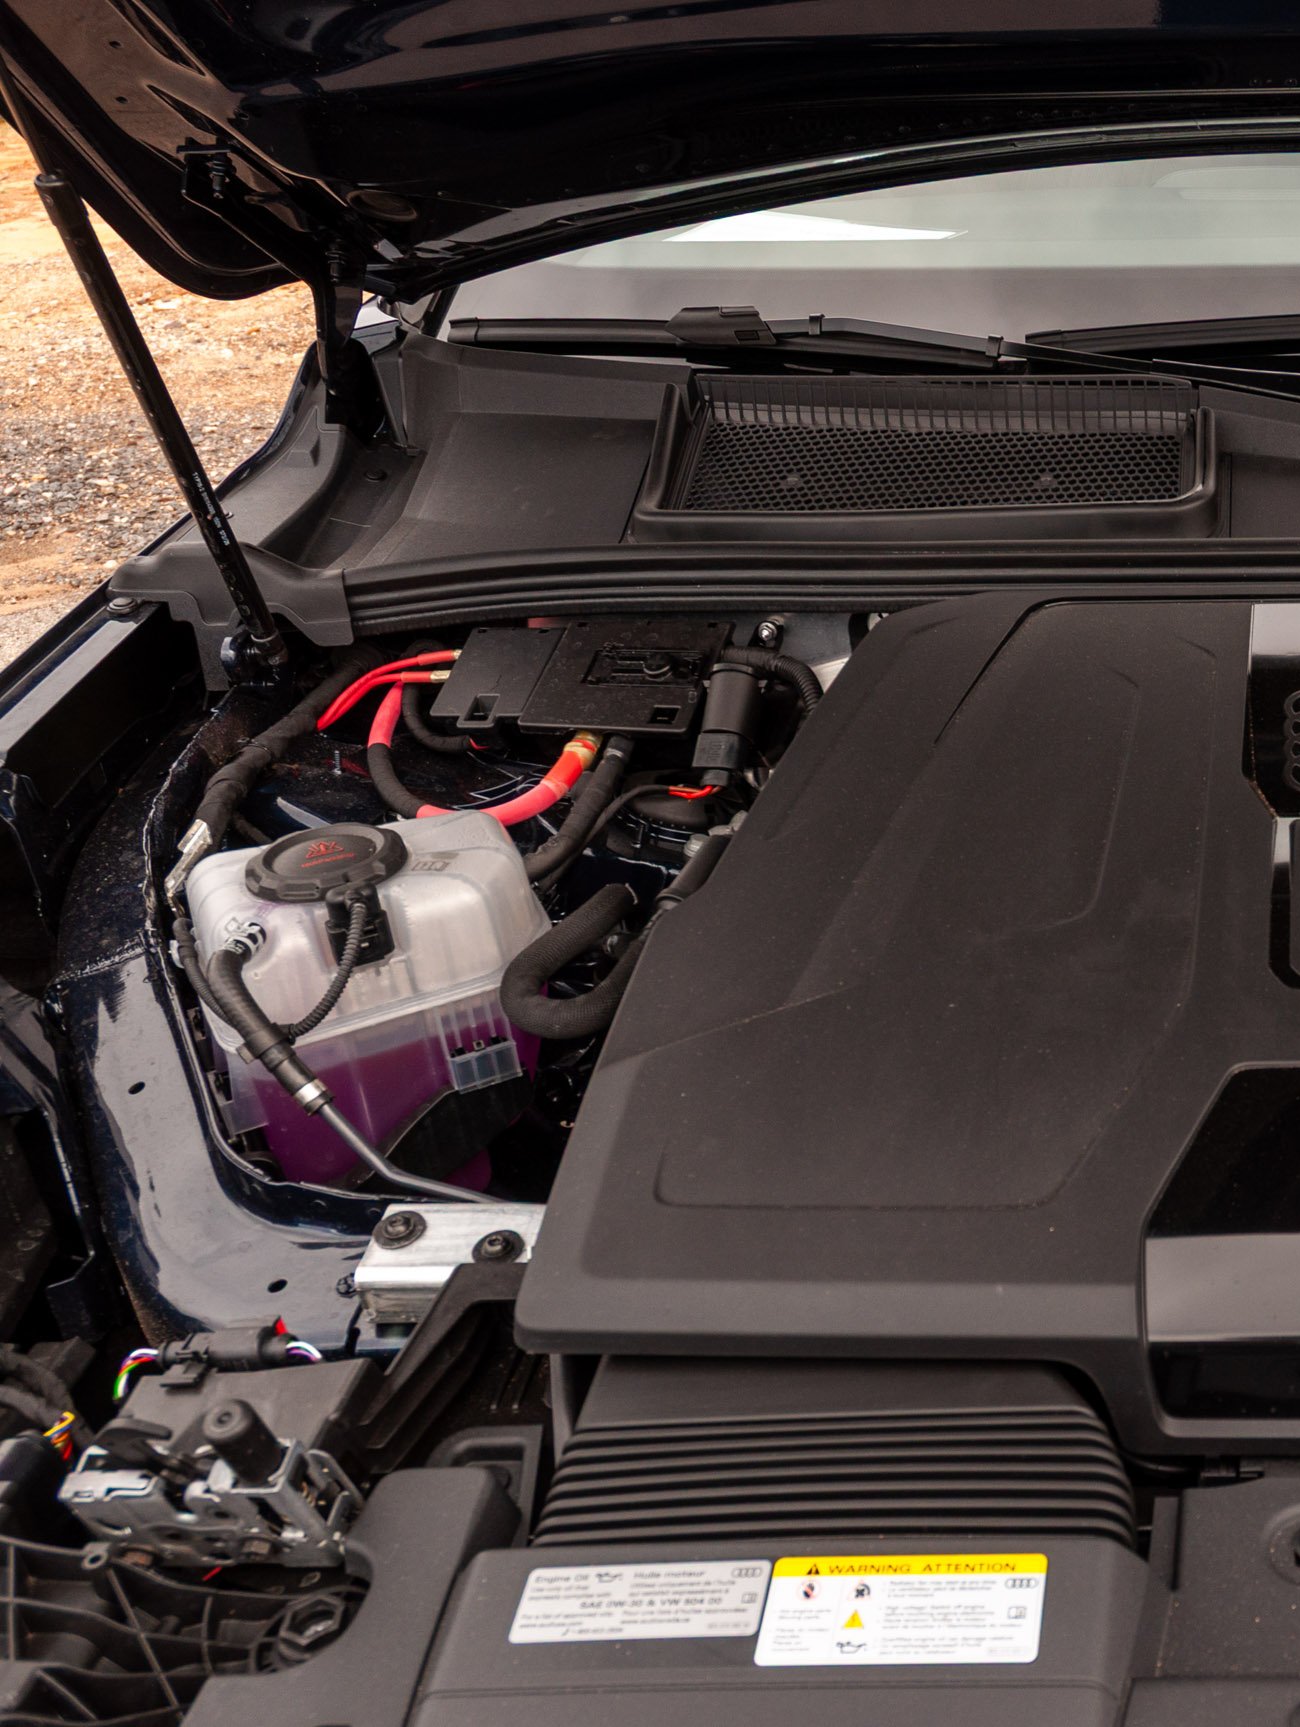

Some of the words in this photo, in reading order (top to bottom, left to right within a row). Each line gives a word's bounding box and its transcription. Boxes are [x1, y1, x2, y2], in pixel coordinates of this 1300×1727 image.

[664, 1569, 705, 1577] moteur
[828, 1563, 912, 1574] WARNING
[922, 1562, 1017, 1573] ATTENTION
[534, 1575, 571, 1584] Engine
[580, 1601, 602, 1610] SAE
[660, 1598, 680, 1606] VW
